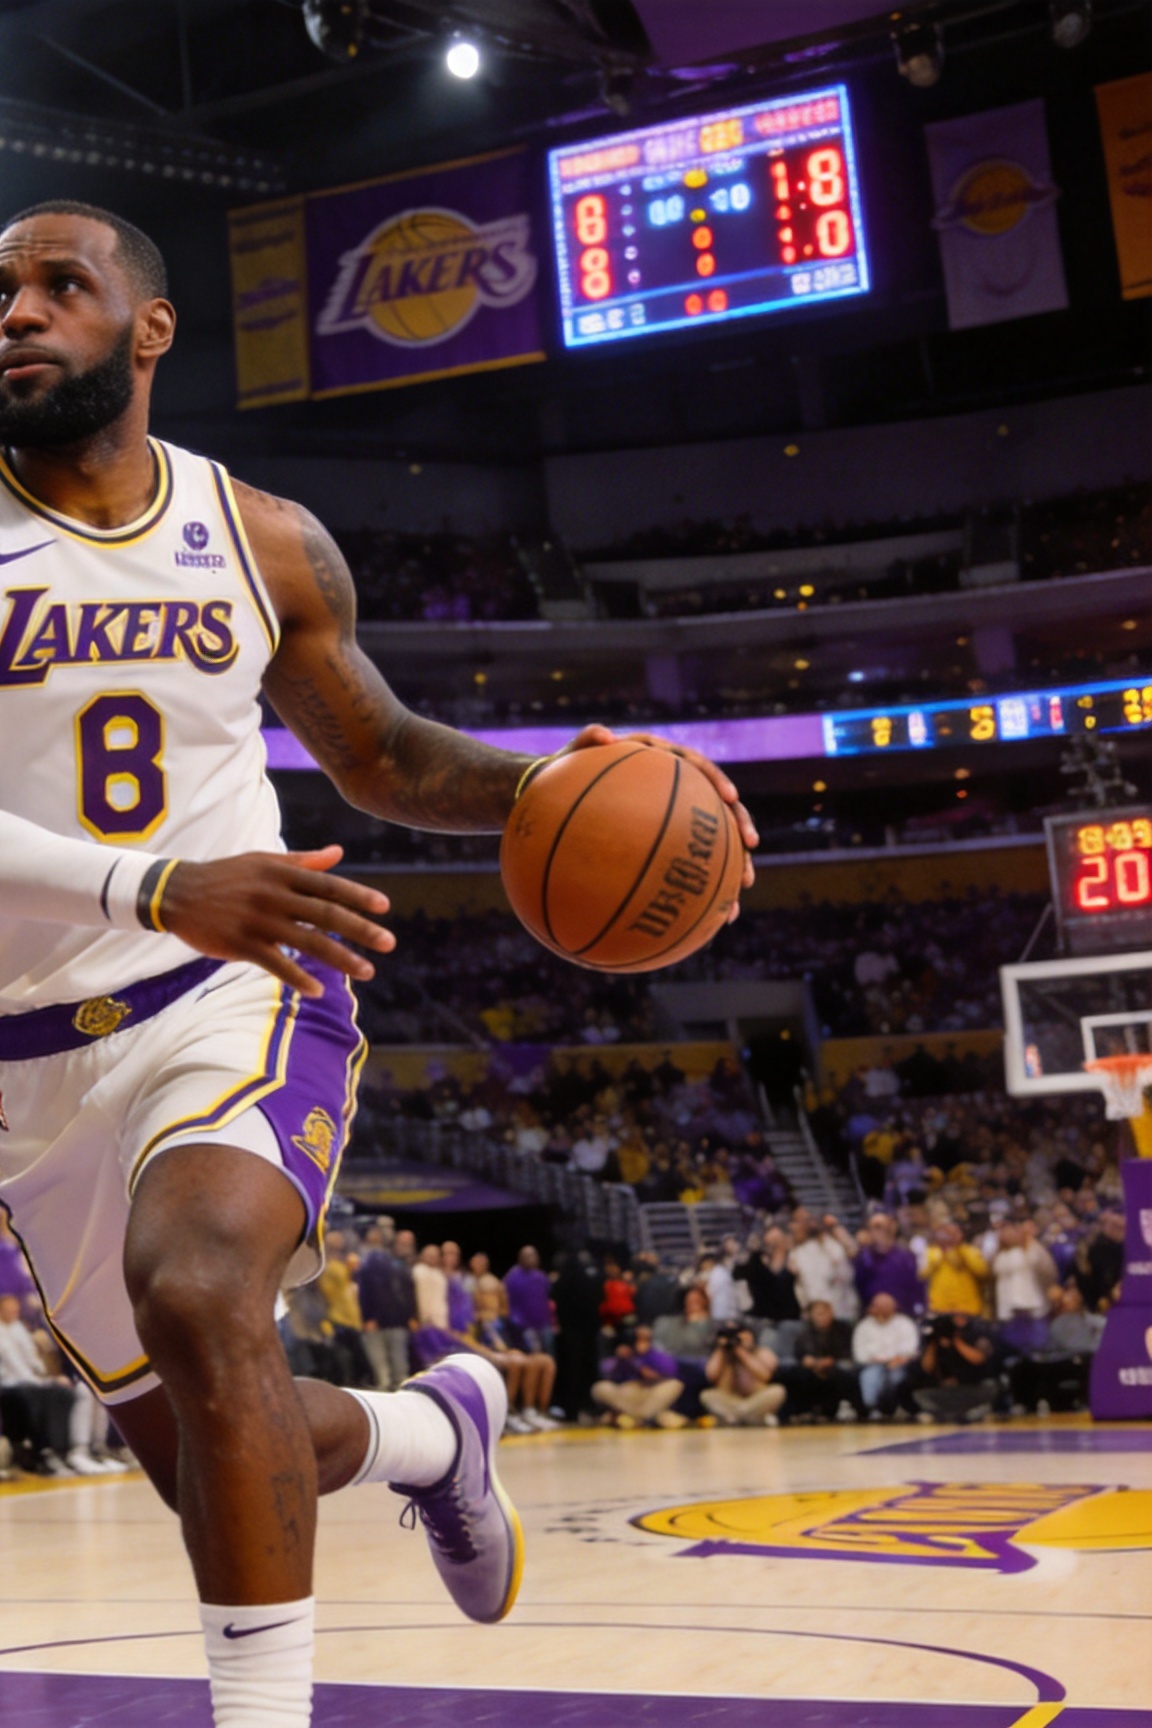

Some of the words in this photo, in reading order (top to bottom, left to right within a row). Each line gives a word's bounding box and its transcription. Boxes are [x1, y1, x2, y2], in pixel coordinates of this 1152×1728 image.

[326, 238, 522, 325] LAKERS
[73, 687, 168, 842] 8
[1078, 851, 1150, 907] 20
